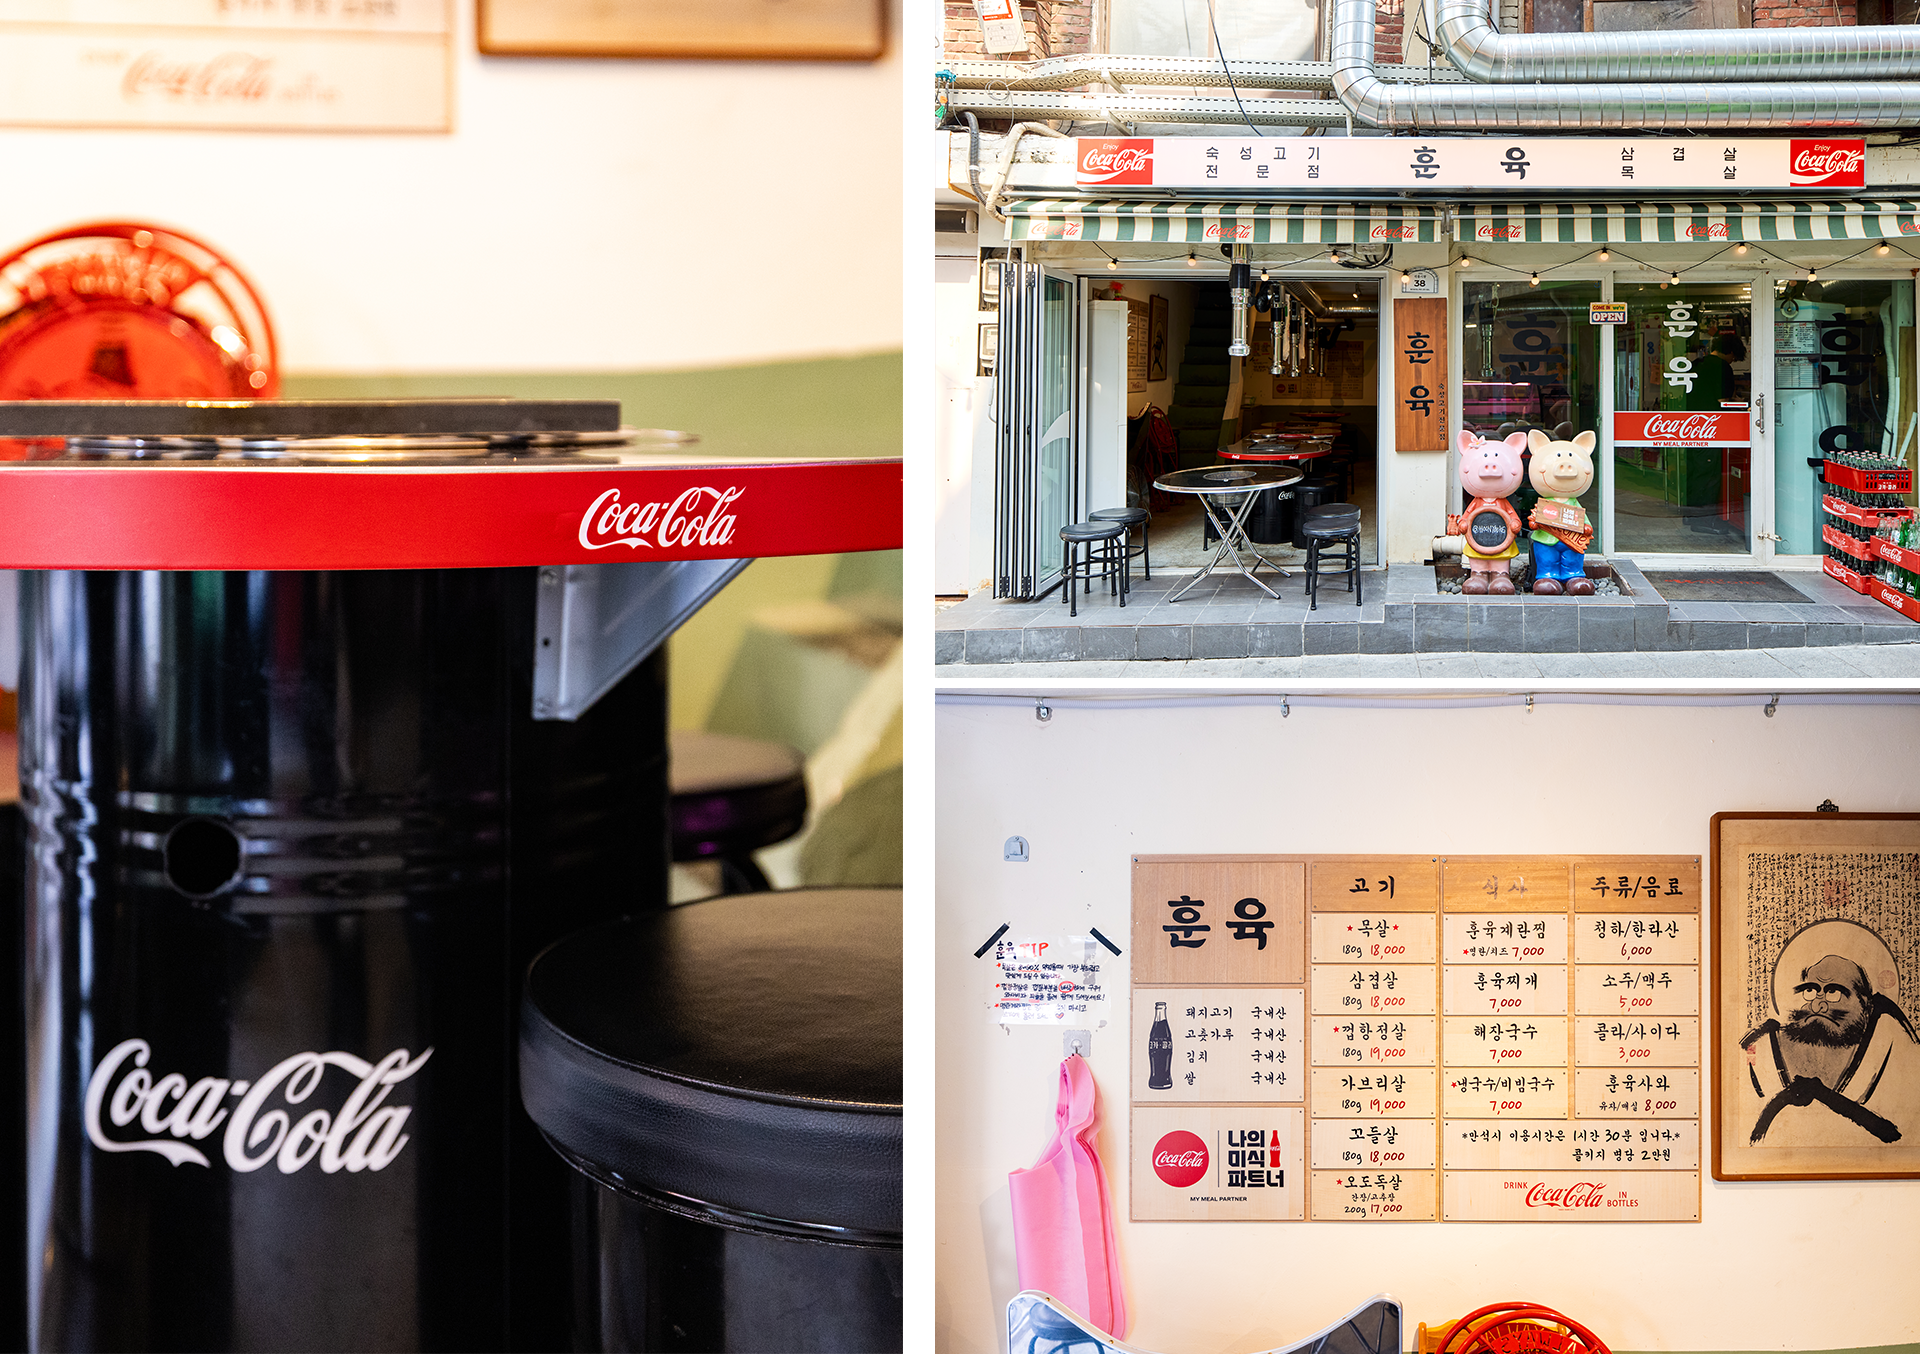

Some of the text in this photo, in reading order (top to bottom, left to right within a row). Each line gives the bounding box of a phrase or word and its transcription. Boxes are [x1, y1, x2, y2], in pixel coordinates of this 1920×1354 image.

[1102, 143, 1119, 151] Enjoy
[1813, 144, 1831, 152] Enjoy
[1082, 148, 1152, 172] Coca-Cola
[1794, 150, 1862, 174] Coca-Cola
[1031, 222, 1081, 236] Coca-Cola
[1206, 223, 1252, 239] Coca-Cola
[1371, 224, 1417, 239] Coca-Cola
[1477, 224, 1522, 238] Coca-Cola
[1685, 222, 1731, 238] Coca-Cola
[1592, 312, 1625, 321] OPEN
[1404, 332, 1434, 417] 훈육
[1643, 414, 1722, 438] Coca-Cola
[578, 486, 747, 550] Coca-Cola
[1349, 875, 1394, 899] 고기
[1591, 876, 1684, 898] 주류/음료
[1162, 895, 1275, 950] 훈육
[1358, 919, 1390, 938] 목살
[1465, 920, 1546, 940] 훈육계란찜
[1593, 920, 1680, 940] 청하/한라산
[1018, 942, 1049, 958] TIP
[1342, 944, 1405, 959] 180g 18,000
[1511, 946, 1545, 960] 7,000
[1621, 943, 1653, 960] 6,000
[1349, 971, 1398, 989] 삼겹살
[1474, 972, 1538, 991] 훈육찌개
[1602, 972, 1673, 990] 소주/맥주
[1342, 996, 1405, 1011] 180g 18,000
[1489, 998, 1522, 1012] 7,000
[1619, 995, 1653, 1012] 5,000
[1185, 1006, 1286, 1019] 돼지고기 국내산
[1185, 1028, 1286, 1041] 고춧가루 국내산
[1473, 1023, 1538, 1042] 해장국수
[1593, 1023, 1681, 1041] 콜라/사이다
[1187, 1050, 1286, 1063] 김치 국내산
[1342, 1046, 1406, 1062] 180g 19,000
[1489, 1049, 1522, 1063] 7,000
[1618, 1047, 1651, 1063] 3,000
[1184, 1071, 1286, 1085] 쌀 국내산
[1341, 1074, 1406, 1092] 가브리살
[1457, 1077, 1555, 1093] 냉국수/비빔국수
[1605, 1074, 1670, 1093] 훈육사와
[84, 1038, 435, 1174] Coca-Cola
[1341, 1098, 1406, 1114] 180g 19,000
[1489, 1101, 1522, 1115] 7,000
[1644, 1099, 1677, 1115] 8,000
[1228, 1130, 1265, 1148] 나의
[1349, 1125, 1398, 1144] 꼬들살
[1509, 1129, 1566, 1142] 이용시간은
[1573, 1129, 1600, 1142] 1시간
[1605, 1129, 1633, 1142] 30분
[1155, 1150, 1206, 1167] Coca-Cola
[1228, 1150, 1265, 1168] 미식
[1342, 1150, 1405, 1166] 180g 18,000
[1572, 1148, 1671, 1162] 콜키지 병당 2만원
[1228, 1170, 1284, 1188] 파트너
[1344, 1173, 1402, 1190] 오도독살
[1351, 1193, 1395, 1202] 간장/고추장
[1525, 1182, 1607, 1208] Coca-Cola
[1344, 1204, 1403, 1218] 200g 17,000
